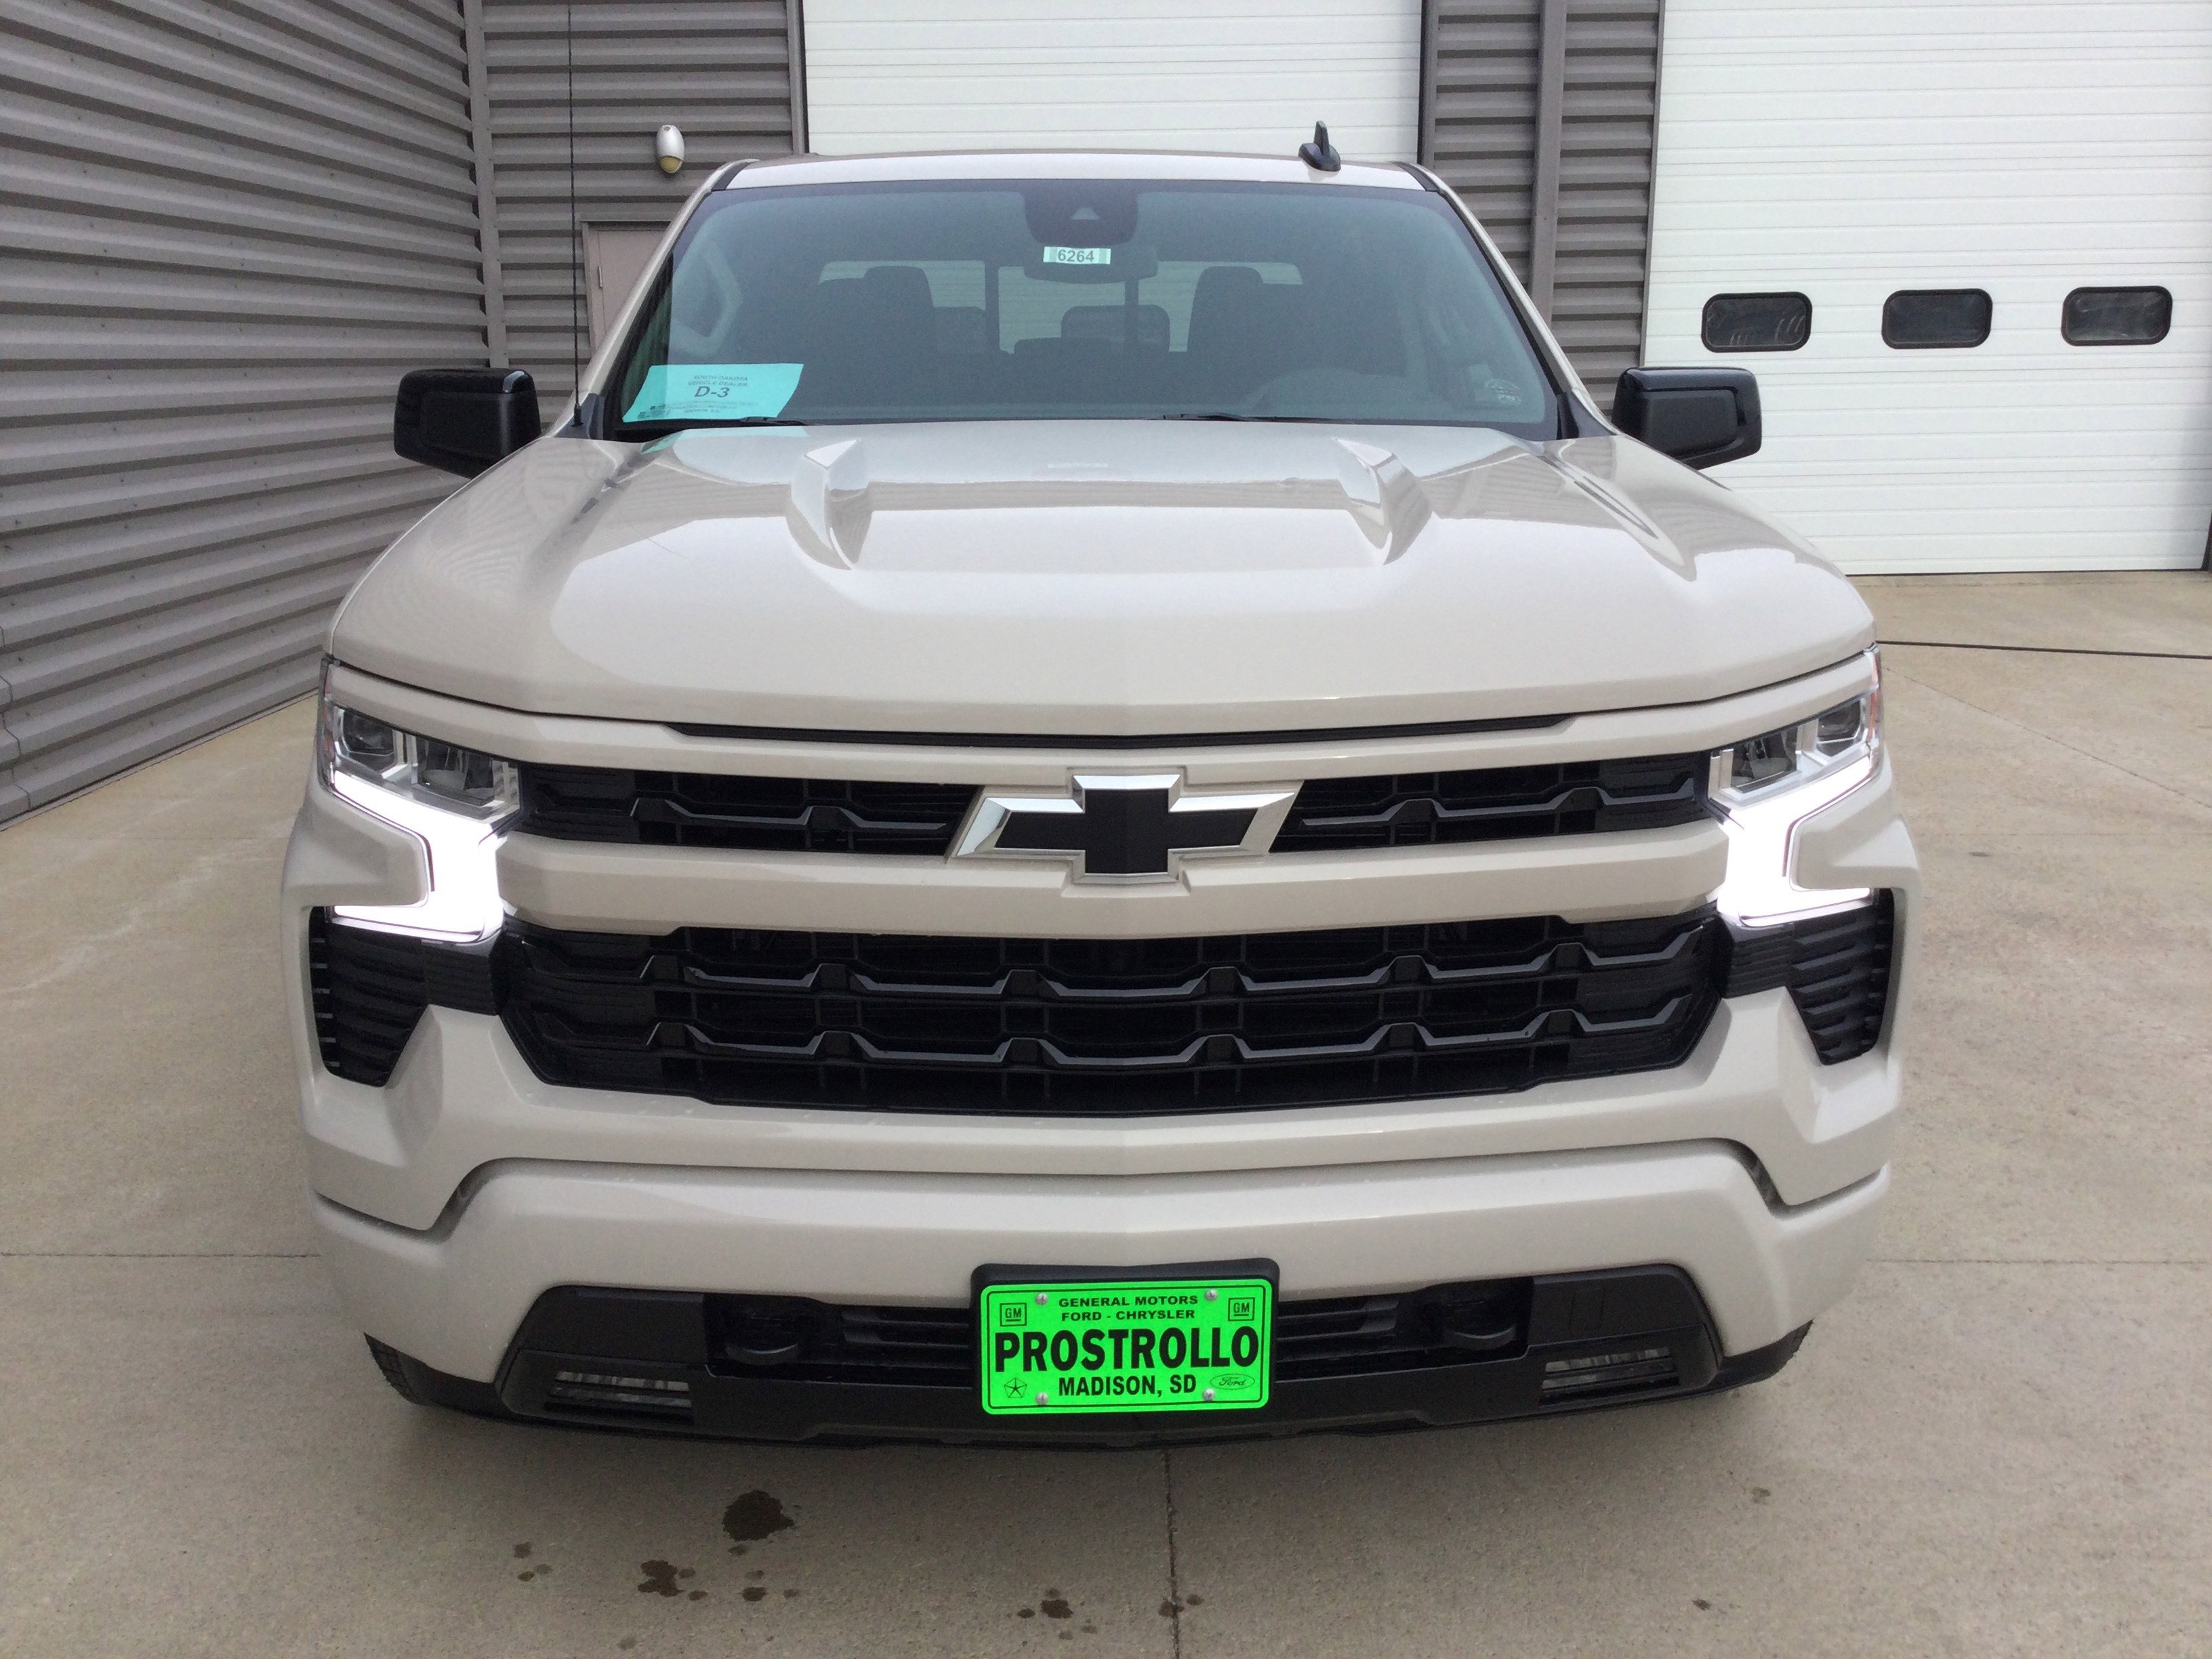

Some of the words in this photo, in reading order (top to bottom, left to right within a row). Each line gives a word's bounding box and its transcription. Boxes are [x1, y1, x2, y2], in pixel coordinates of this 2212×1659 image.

[1057, 249, 1094, 262] 6264
[694, 386, 730, 398] D-3
[1059, 1296, 1130, 1307] GENERAL
[1134, 1295, 1198, 1306] MOTORS
[1005, 1308, 1022, 1319] GM
[1233, 1302, 1250, 1314] GM
[1061, 1311, 1103, 1322] FORD
[1115, 1309, 1195, 1321] CHRYSLER
[994, 1326, 1259, 1373] PROSTROLLO
[1059, 1375, 1163, 1397] MADISON,
[1169, 1374, 1197, 1394] SD
[1218, 1376, 1246, 1388] Ford
